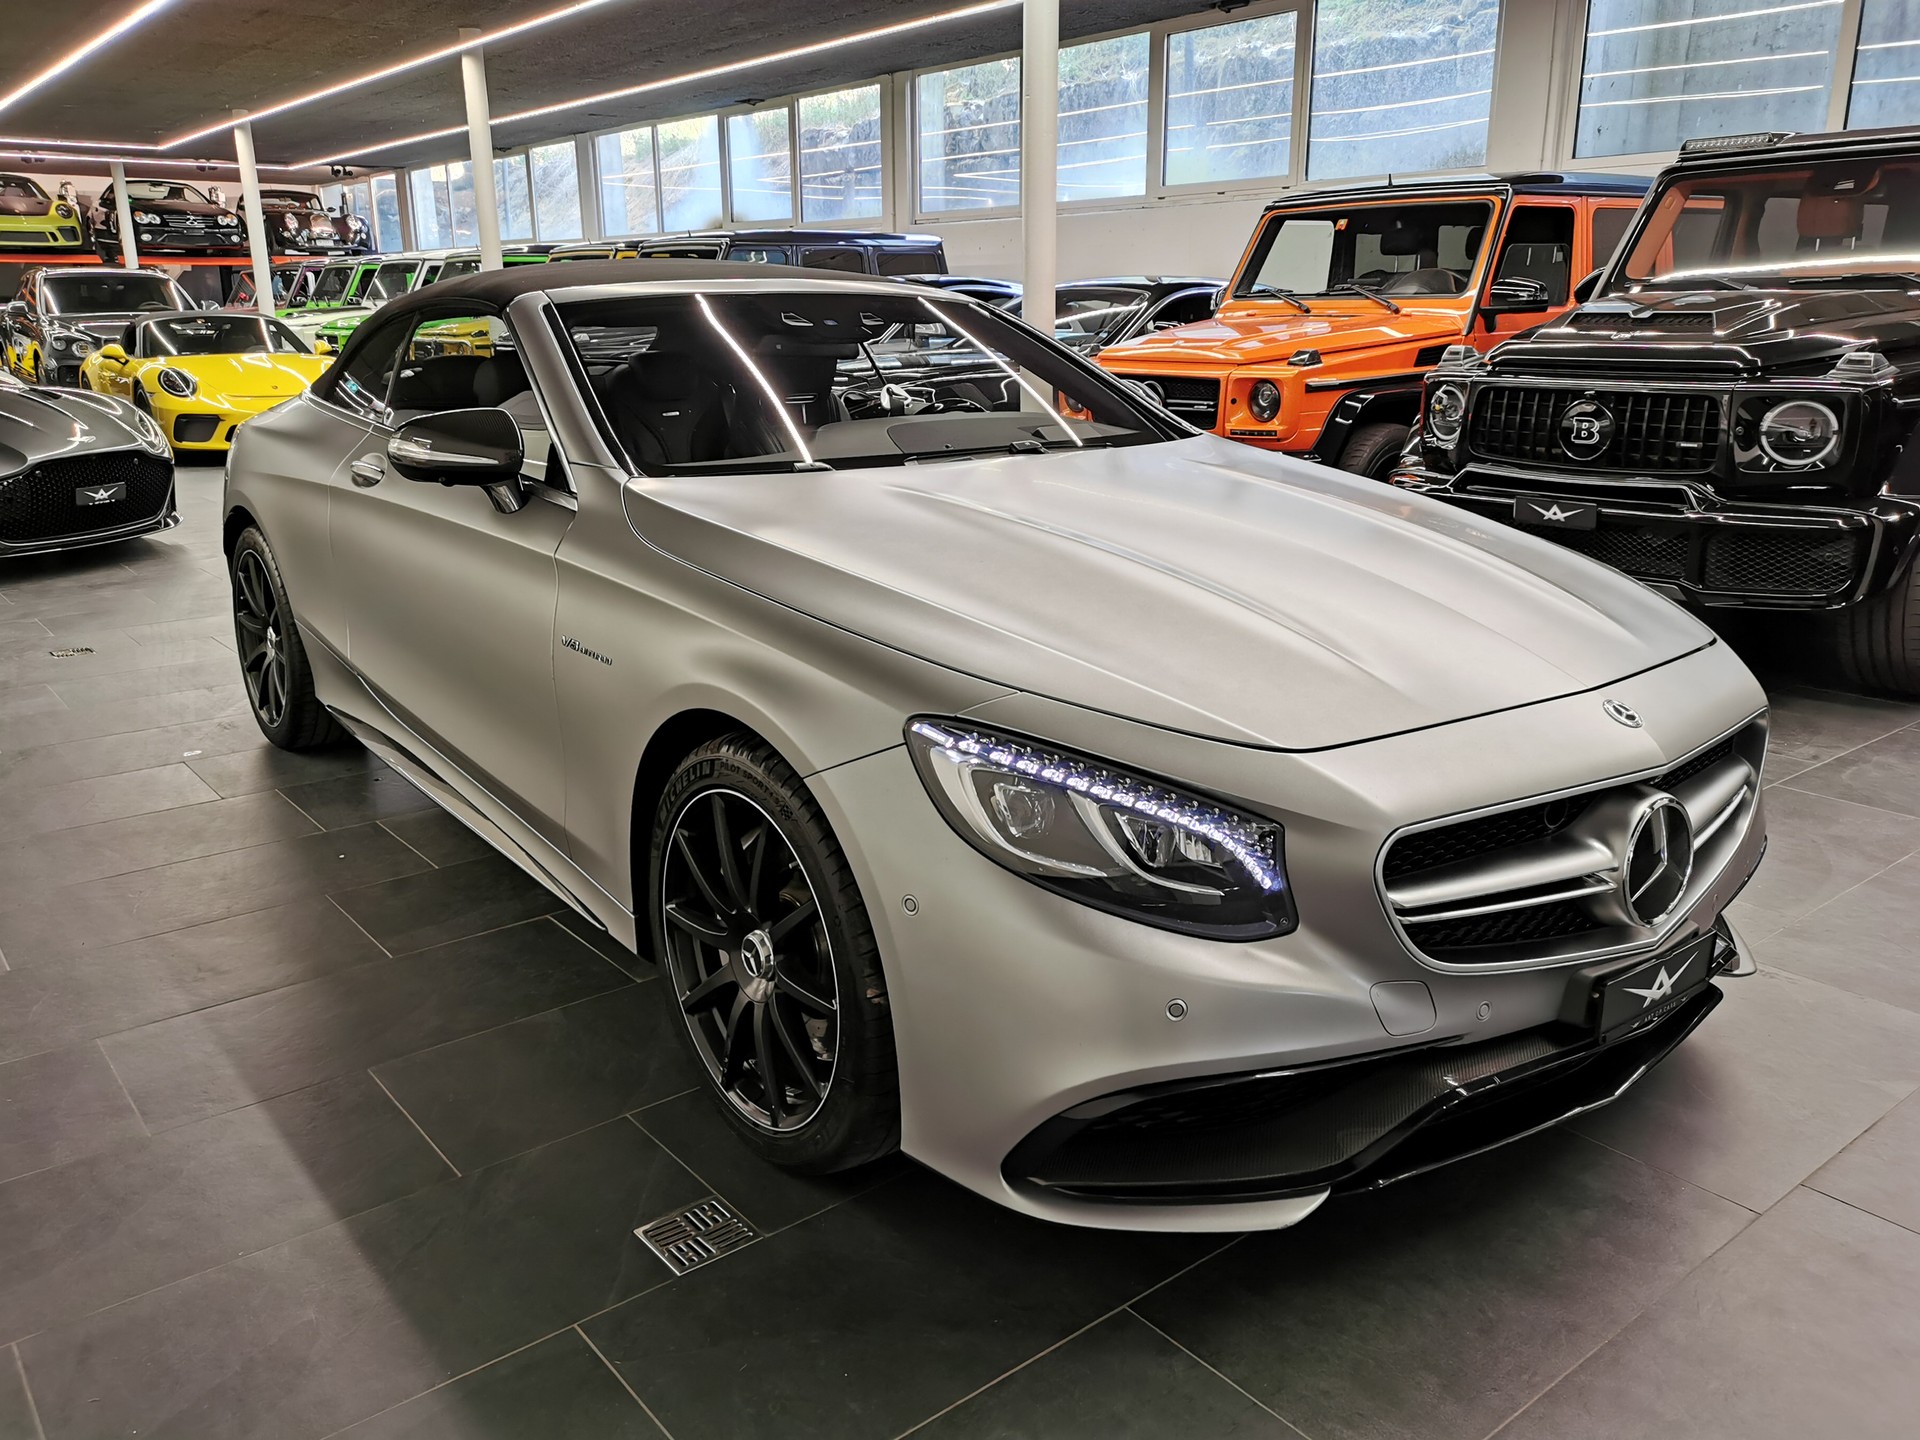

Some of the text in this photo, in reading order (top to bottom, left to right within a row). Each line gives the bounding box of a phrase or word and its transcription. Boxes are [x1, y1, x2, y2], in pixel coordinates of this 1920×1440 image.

[1571, 416, 1600, 444] B
[659, 759, 711, 826] MICHELIN
[720, 759, 741, 774] PILOT
[742, 770, 769, 793] SPORT
